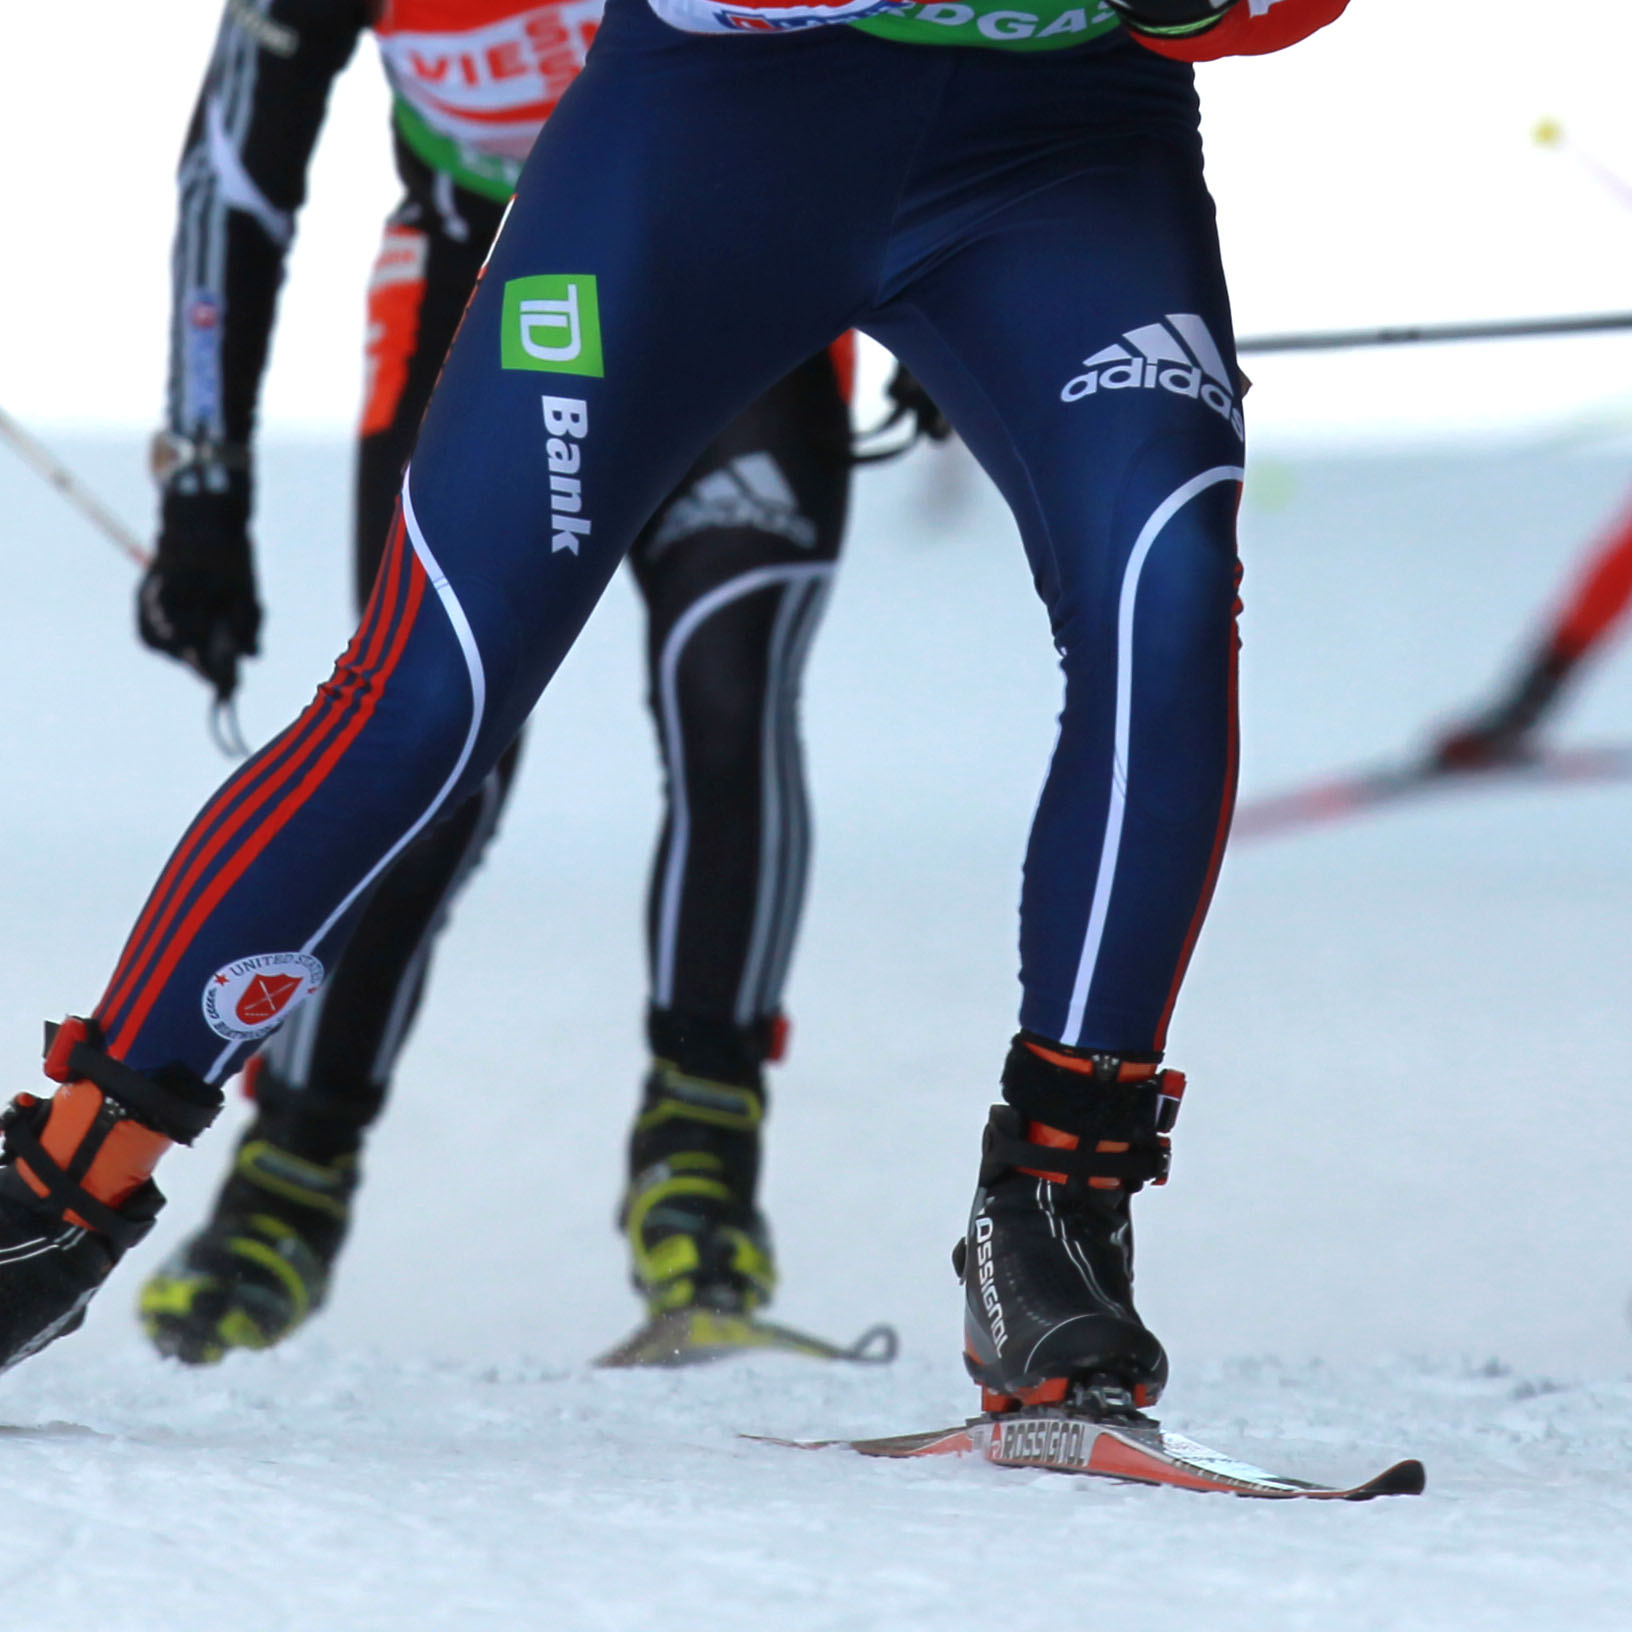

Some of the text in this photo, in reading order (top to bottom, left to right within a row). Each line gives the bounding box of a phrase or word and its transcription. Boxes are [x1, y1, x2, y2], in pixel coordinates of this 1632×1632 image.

[519, 283, 592, 557] TD Bank
[1060, 356, 1245, 443] adidas
[230, 954, 295, 976] UNITED
[975, 1215, 1008, 1359] OSSIGNOL
